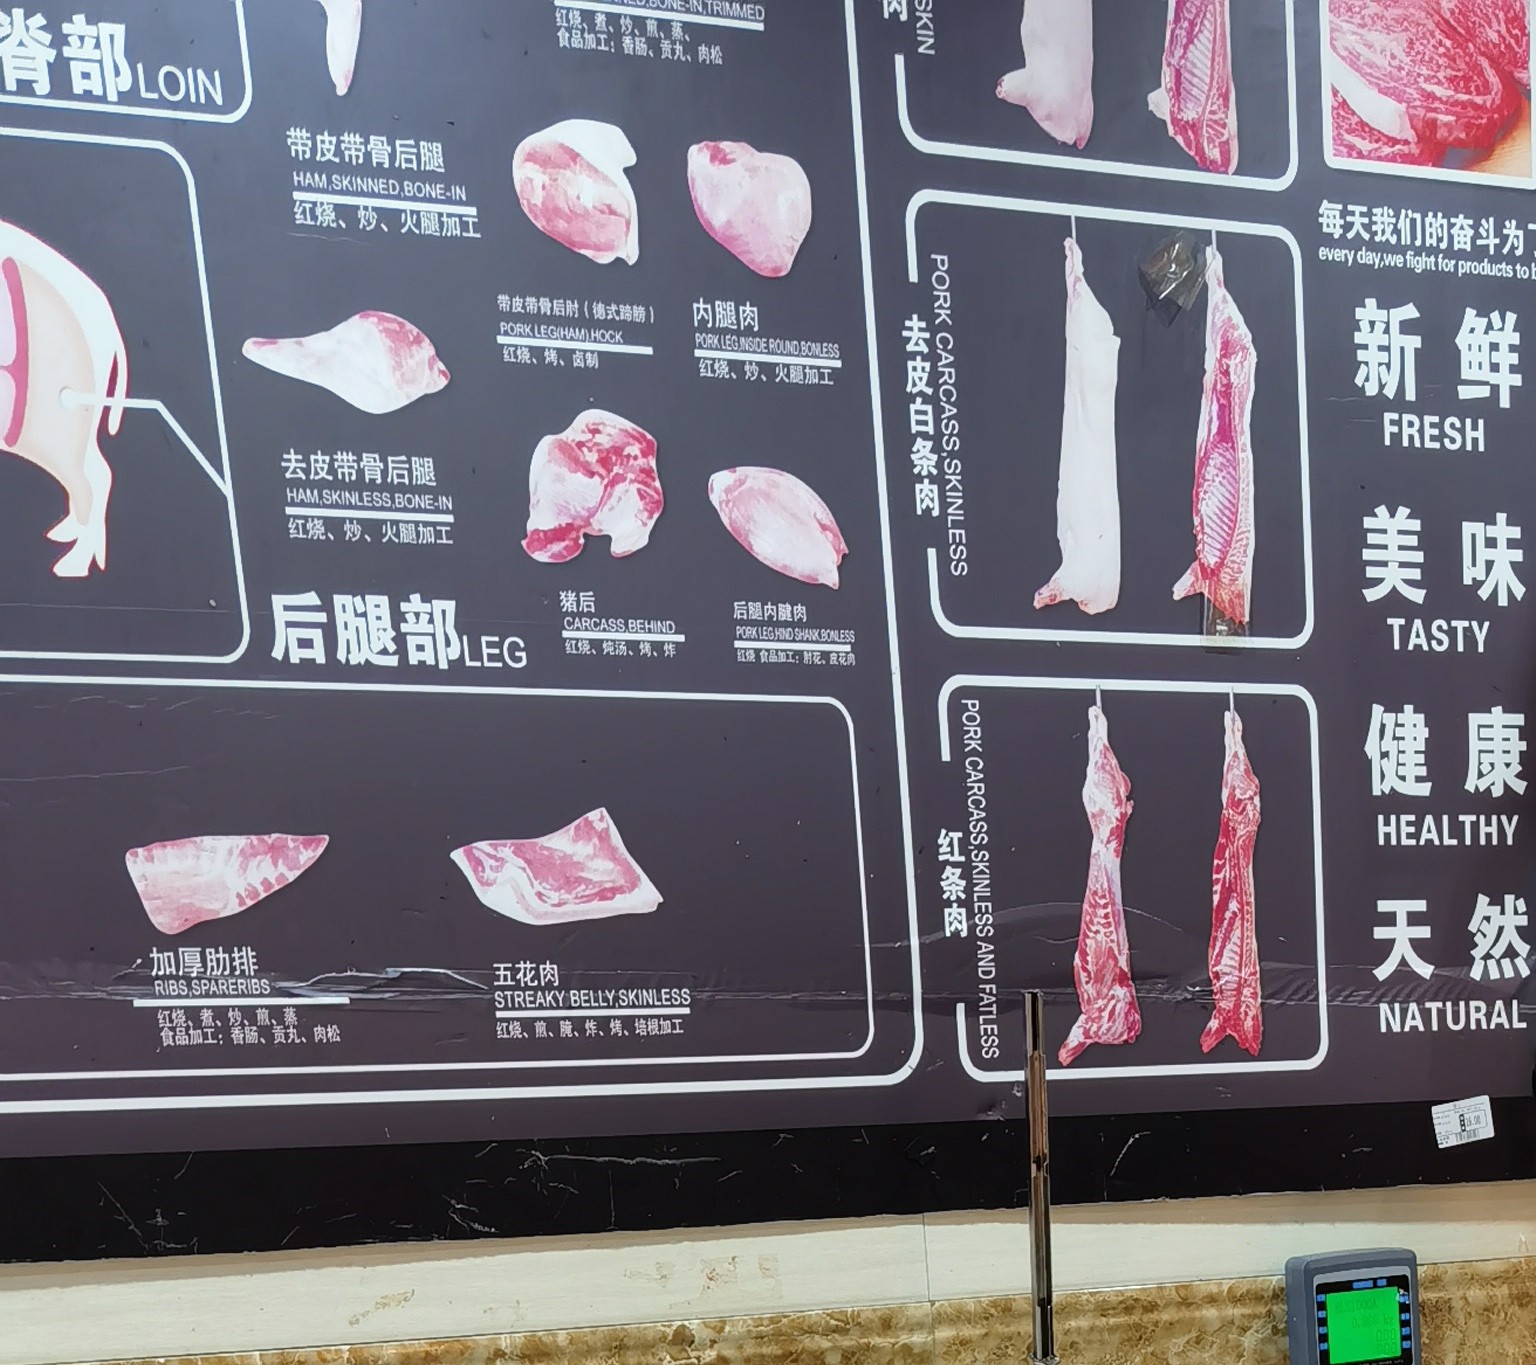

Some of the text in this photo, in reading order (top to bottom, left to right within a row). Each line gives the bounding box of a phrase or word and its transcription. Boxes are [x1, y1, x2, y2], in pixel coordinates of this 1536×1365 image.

[137, 63, 222, 105] LOIN
[286, 126, 445, 172] 带皮带骨后腿
[293, 171, 467, 201] HAM,SKINNED,BONE-IN
[293, 200, 481, 238] 红烧、炒、火腿加工
[1318, 245, 1355, 266] every
[1357, 247, 1404, 269] day,we
[1406, 251, 1435, 273] fight
[1437, 253, 1456, 271] for
[1458, 258, 1513, 278] products
[1516, 264, 1529, 279] to
[500, 321, 532, 337] PORK
[692, 297, 759, 332] 内腿肉
[695, 333, 720, 349] PORK
[1354, 298, 1523, 409] 新鲜
[699, 358, 834, 385] 红烧、炒、火腿加工
[902, 314, 939, 517] 去皮白条肉
[930, 253, 968, 576] PORK CARCASS,SKINLESS
[1383, 412, 1485, 452] FRESH
[281, 448, 437, 486] 去皮带骨后腿
[286, 487, 452, 511] HAM,SKINLESS,BONE-IN
[288, 517, 453, 545] 红烧、炒、火腿加工
[1361, 504, 1527, 607] 美味
[559, 590, 595, 613] 猪后
[271, 591, 461, 669] 后腿部
[736, 626, 758, 639] PORK
[1386, 617, 1490, 653] TASTY
[463, 635, 527, 668] LEG
[1364, 703, 1528, 798] 健康
[1377, 814, 1519, 846] HEALTHY
[938, 828, 968, 938] 红条肉
[961, 699, 1000, 1059] PORK CARCASS,SKINLESS AND FATLESS
[1372, 892, 1531, 982] 天然
[150, 946, 258, 976] 加厚肋排
[493, 960, 559, 986] 五花肉
[154, 979, 270, 997] RIBS,SPARERIBS
[495, 988, 691, 1008] STREAKY BELLY,SKINLESS
[1379, 999, 1527, 1033] NATURAL
